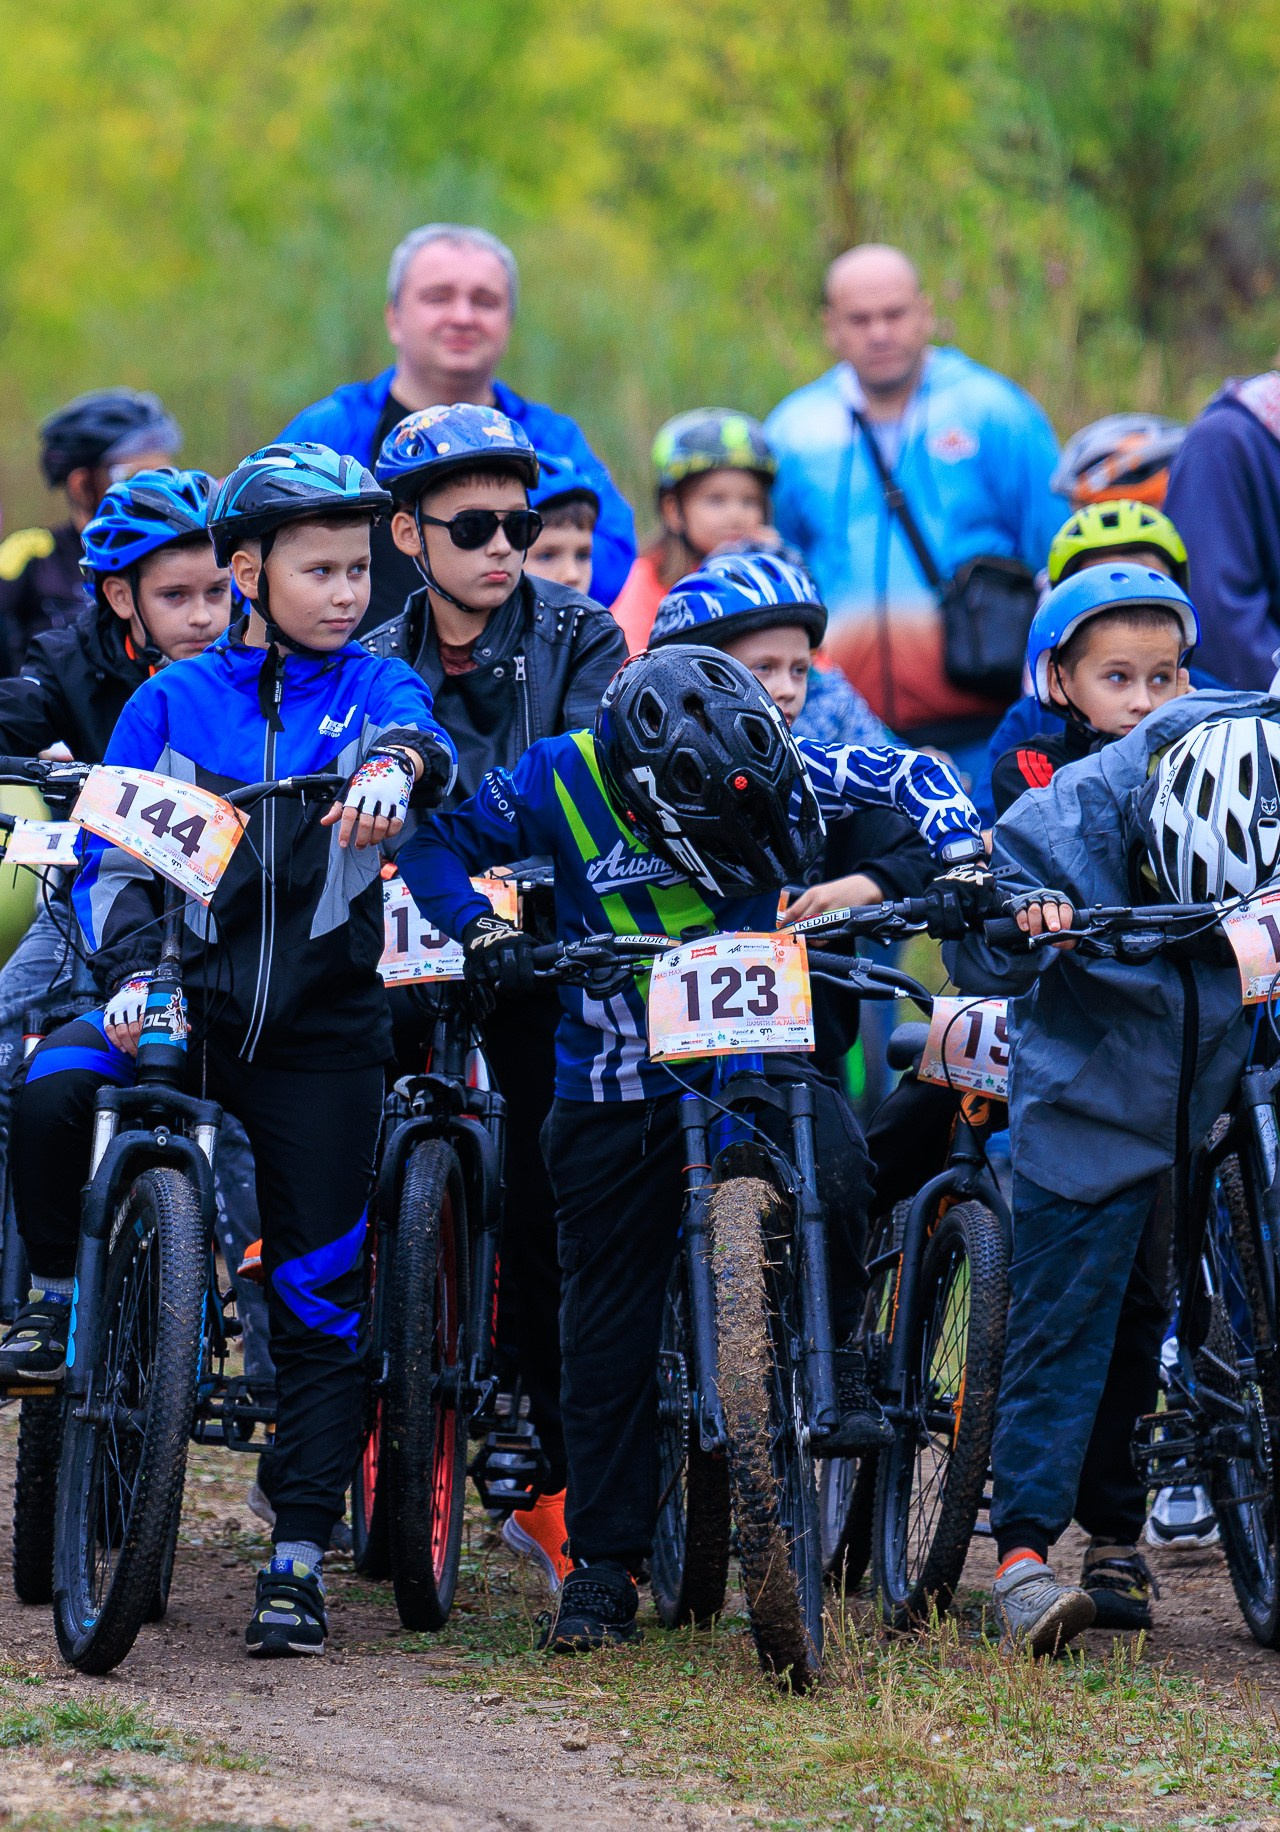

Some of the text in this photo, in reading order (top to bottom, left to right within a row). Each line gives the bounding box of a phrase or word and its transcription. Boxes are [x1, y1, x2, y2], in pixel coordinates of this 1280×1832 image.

[115, 781, 208, 859] 144
[624, 935, 665, 945] KEDDIE
[797, 913, 841, 930] KEDDIE
[680, 965, 779, 1022] 123
